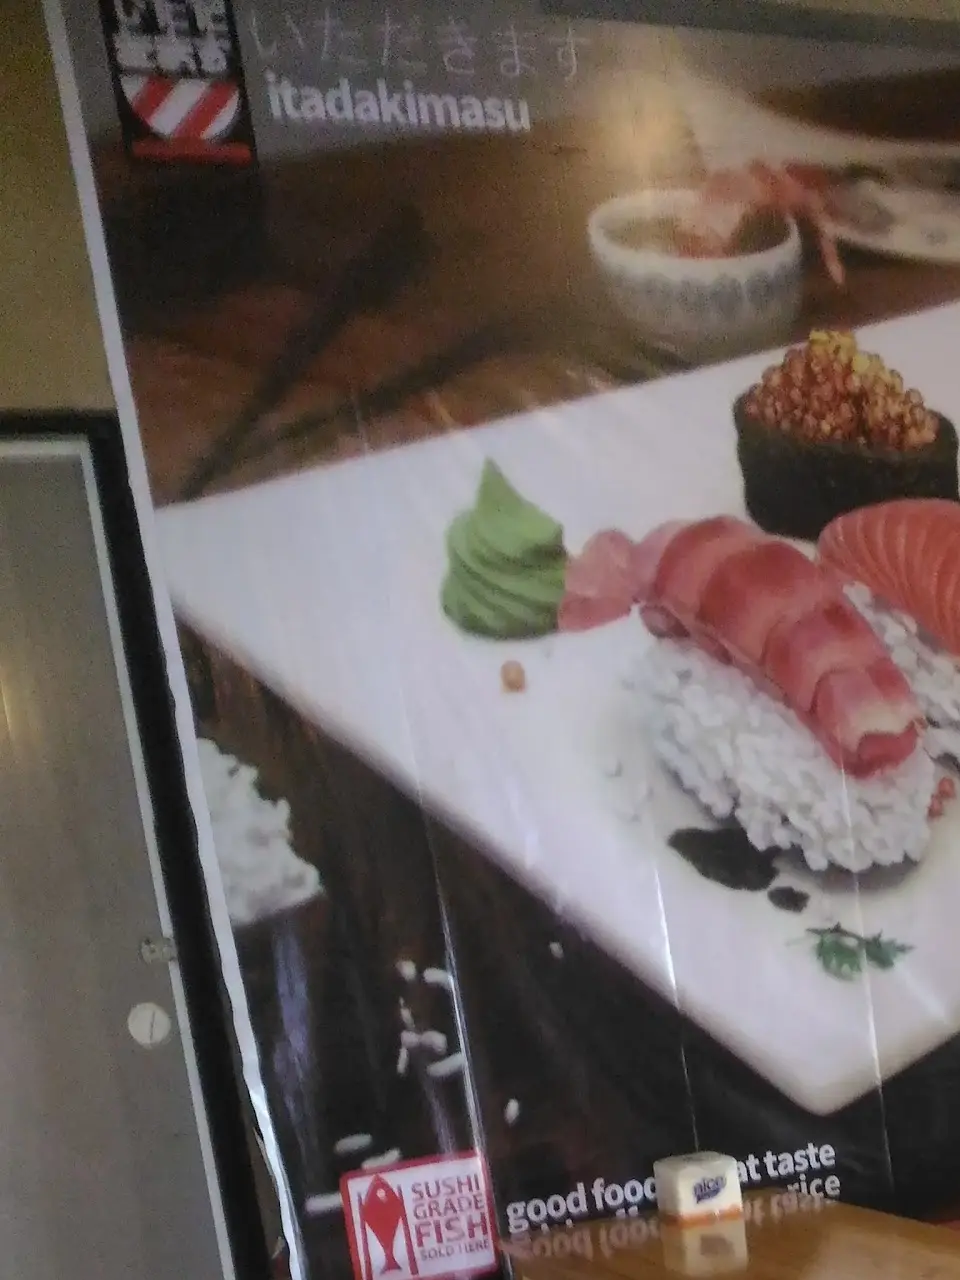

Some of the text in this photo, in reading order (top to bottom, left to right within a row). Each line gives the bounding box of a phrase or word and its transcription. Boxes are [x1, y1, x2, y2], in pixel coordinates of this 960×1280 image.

[250, 8, 591, 81] いただきます
[264, 69, 531, 131] itadakimasu
[411, 1173, 480, 1201] SUSHI
[506, 1181, 588, 1234] good
[764, 1142, 836, 1178] taste
[413, 1193, 485, 1220] GRADE
[414, 1212, 488, 1247] FISH
[420, 1246, 455, 1262] SOLD
